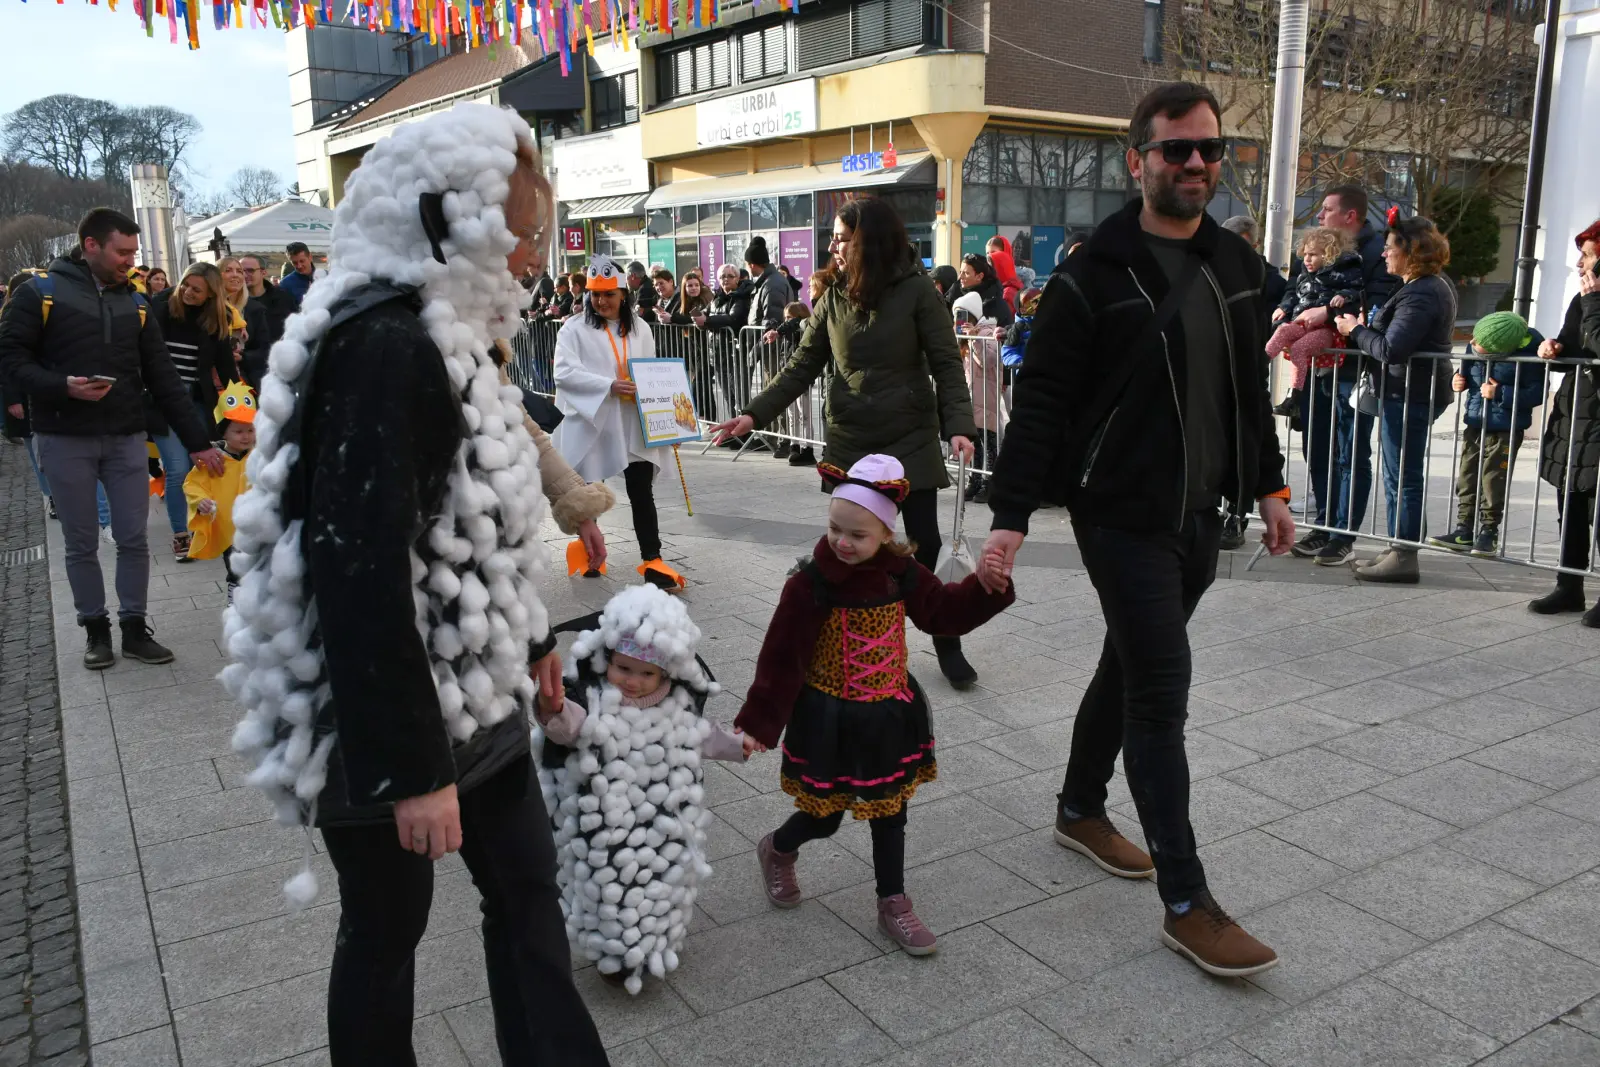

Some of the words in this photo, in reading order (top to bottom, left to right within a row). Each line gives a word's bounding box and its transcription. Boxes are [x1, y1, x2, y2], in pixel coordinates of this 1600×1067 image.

[742, 91, 777, 113] URBIA
[707, 122, 731, 143] urbi
[736, 121, 749, 138] et
[752, 115, 780, 136] orbi
[784, 110, 802, 130] 25
[841, 151, 882, 173] ERSTE
